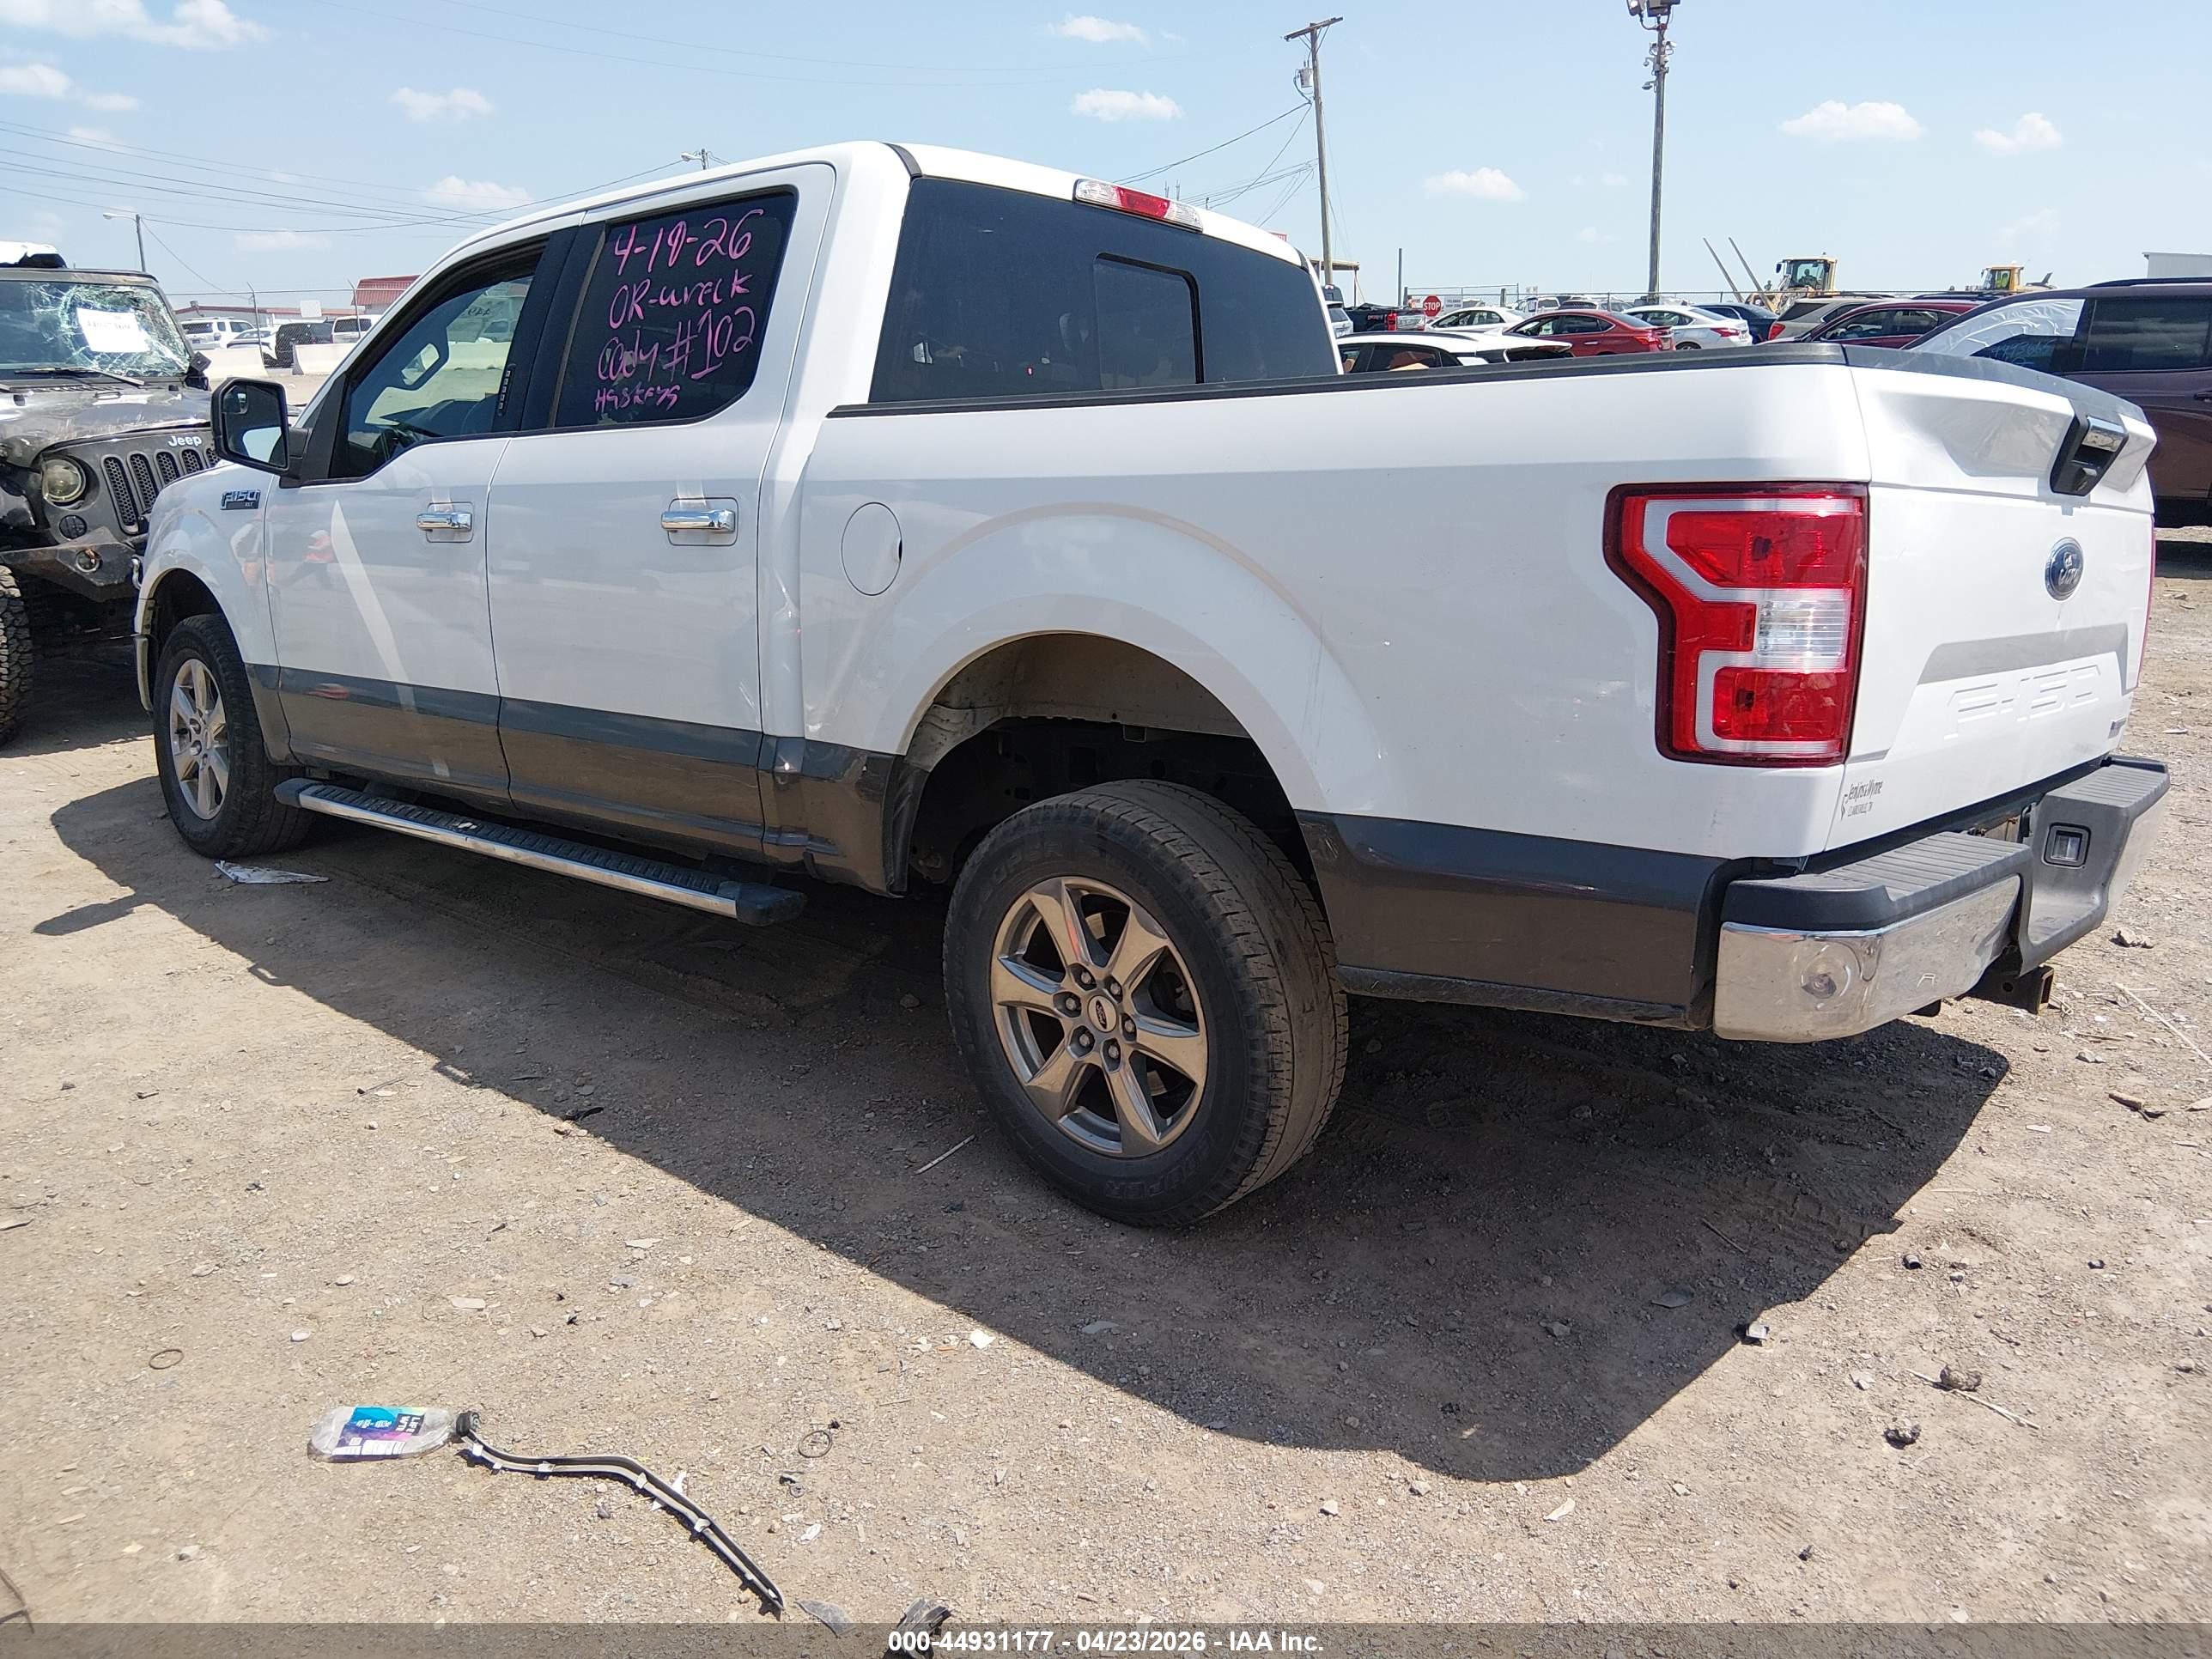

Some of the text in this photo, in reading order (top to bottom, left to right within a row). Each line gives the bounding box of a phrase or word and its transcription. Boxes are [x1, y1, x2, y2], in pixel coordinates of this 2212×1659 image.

[1424, 301, 1441, 311] STOP
[167, 435, 203, 447] Jeep
[1943, 665, 2101, 740] F-150
